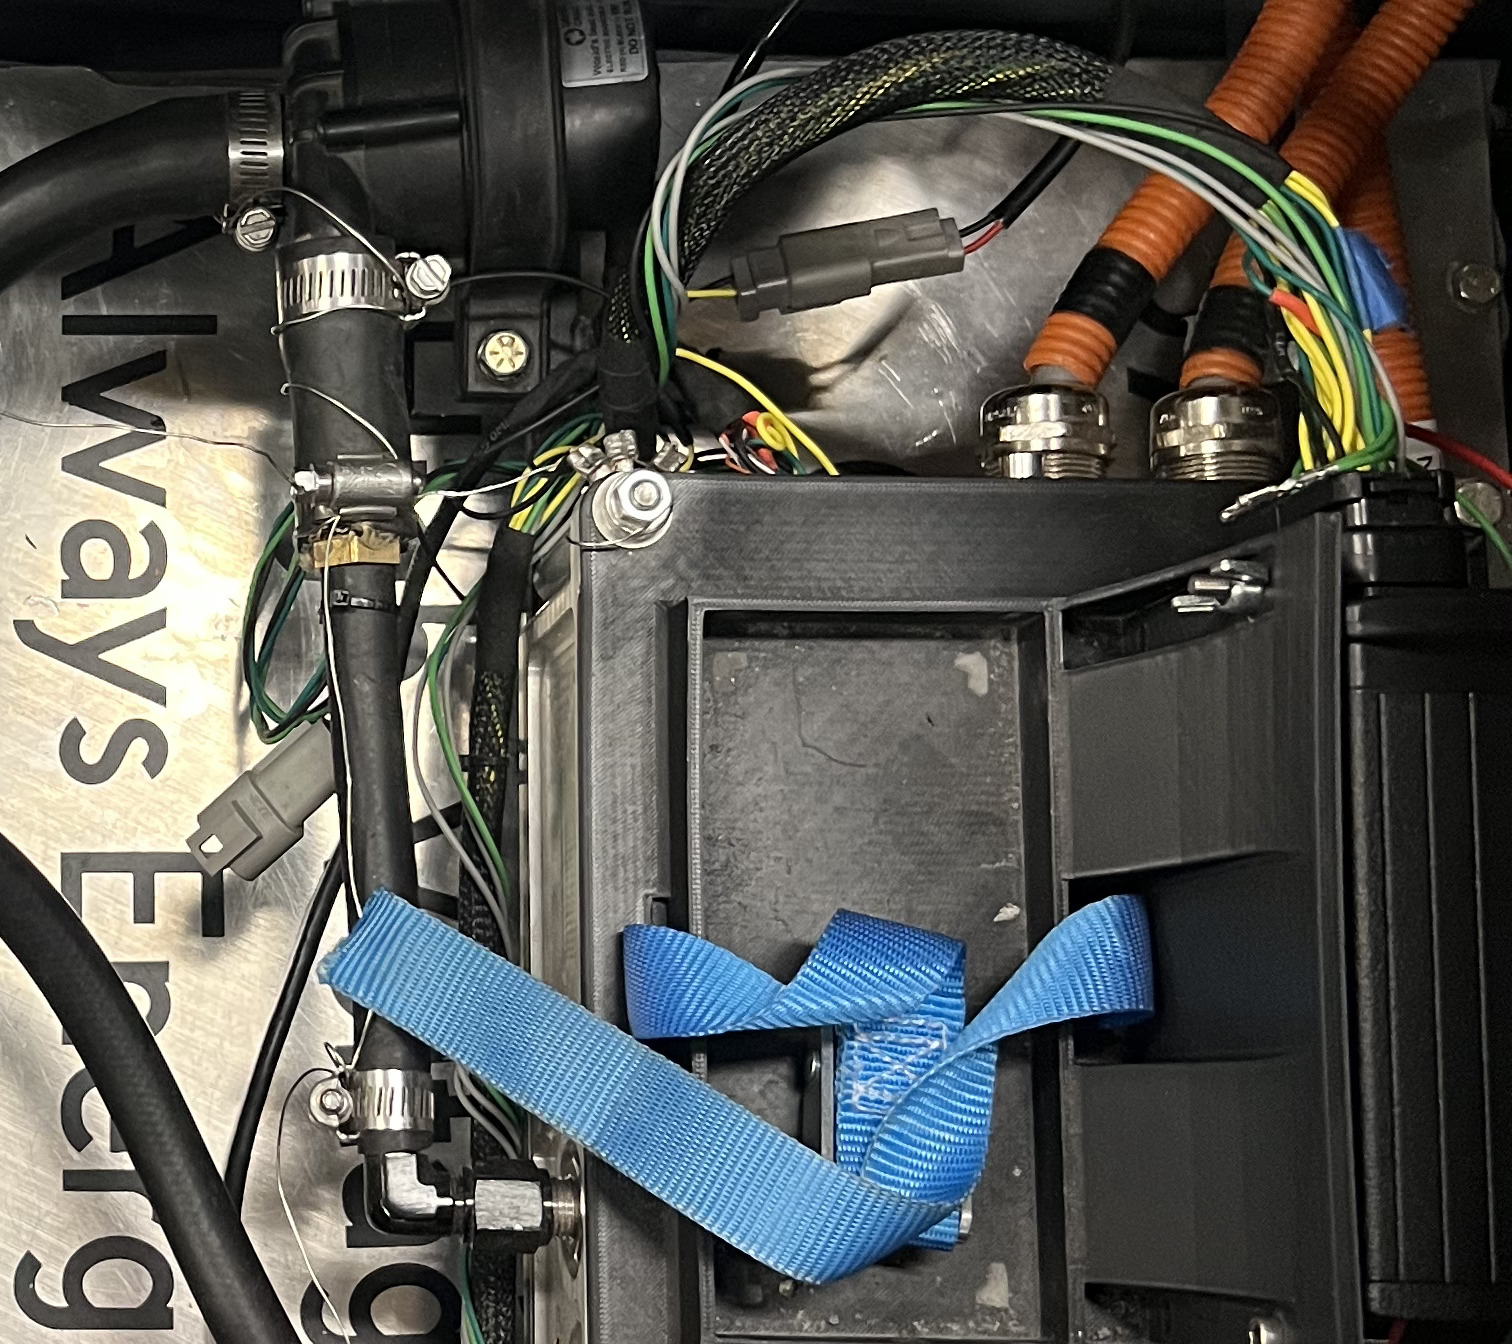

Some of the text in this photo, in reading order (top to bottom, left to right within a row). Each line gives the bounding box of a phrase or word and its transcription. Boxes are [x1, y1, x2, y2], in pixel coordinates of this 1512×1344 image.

[625, 16, 635, 37] NOT
[629, 38, 639, 55] DO
[13, 215, 223, 787] Always
